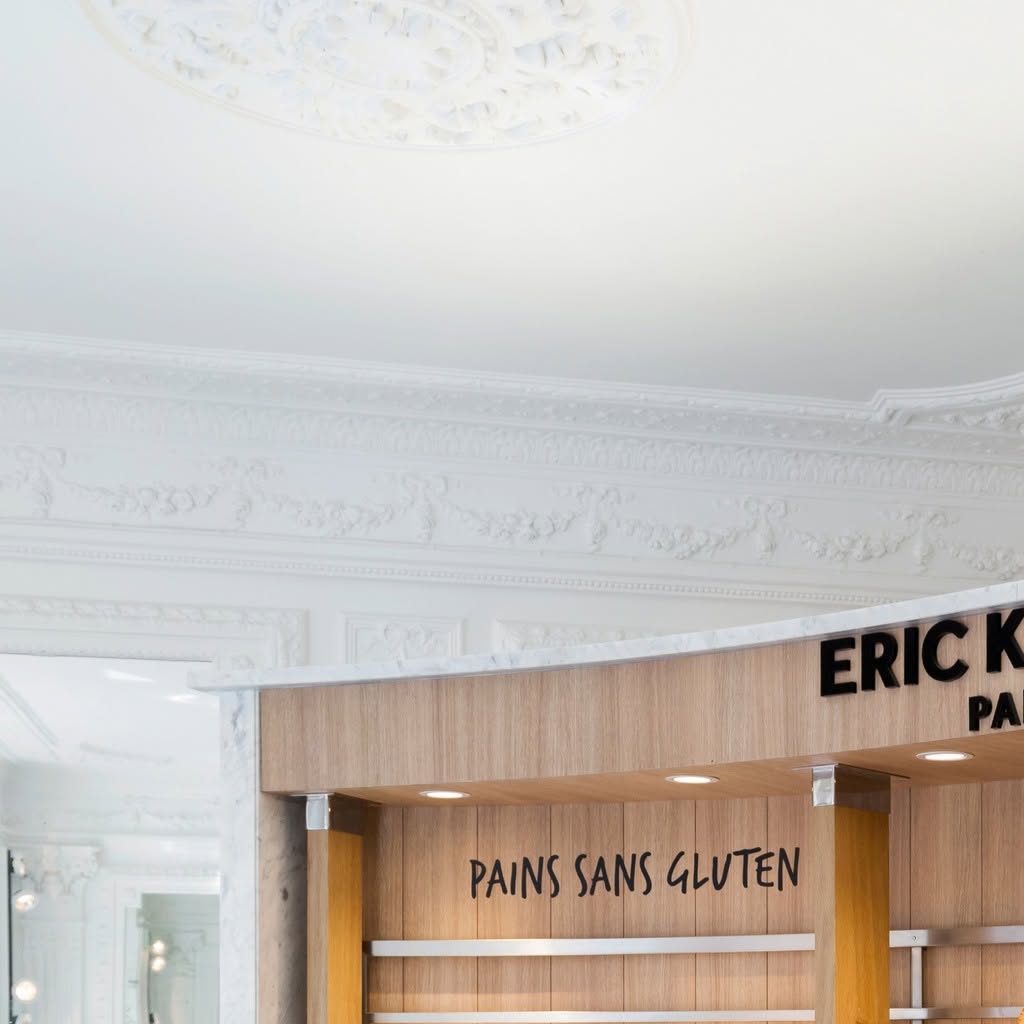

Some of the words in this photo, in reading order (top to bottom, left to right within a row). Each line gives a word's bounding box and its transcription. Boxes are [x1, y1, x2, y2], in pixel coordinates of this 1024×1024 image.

[819, 619, 969, 697] ERIC
[470, 855, 560, 899] PAINS
[574, 852, 652, 896] SANS
[666, 847, 801, 894] GLUTEN
